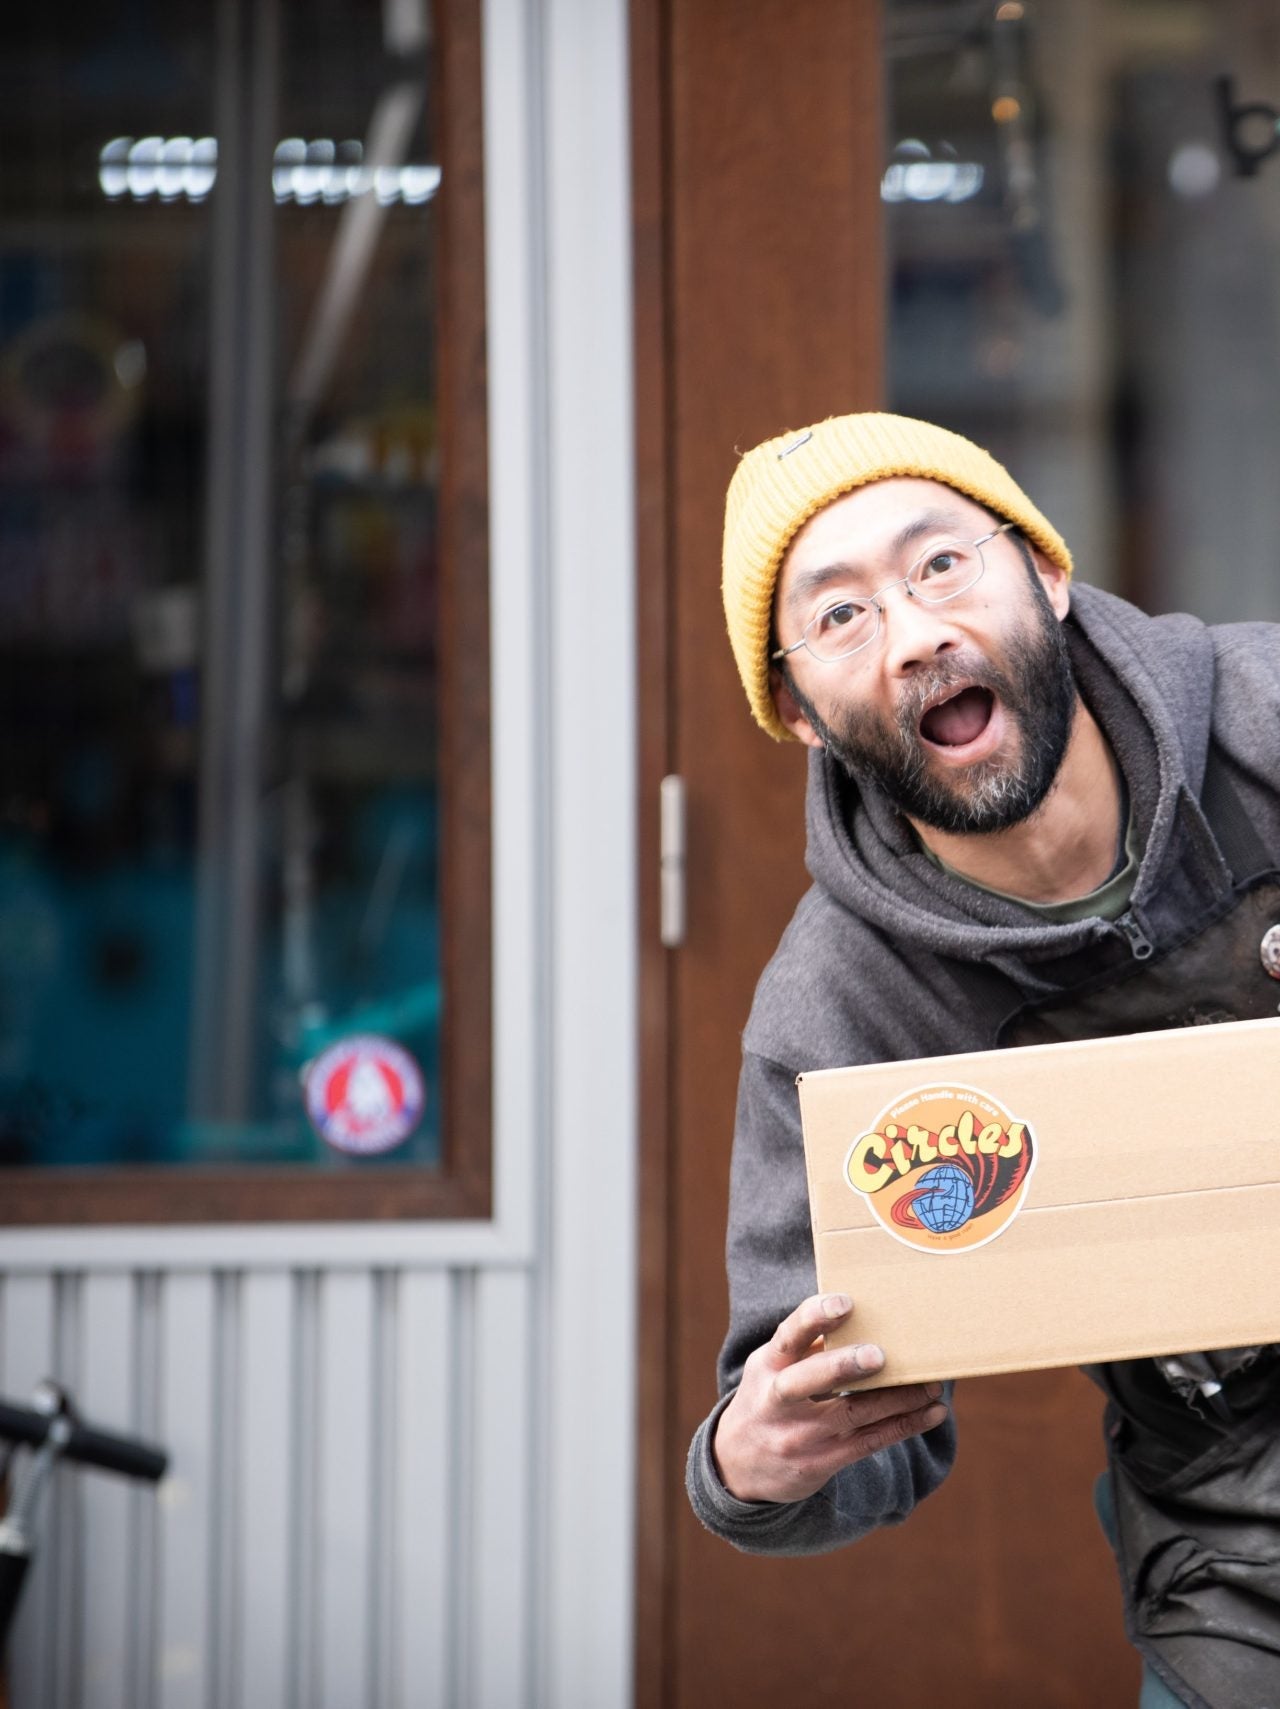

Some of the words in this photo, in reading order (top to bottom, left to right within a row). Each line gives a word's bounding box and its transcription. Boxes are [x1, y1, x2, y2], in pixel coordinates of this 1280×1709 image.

[956, 1093, 978, 1105] with
[979, 1101, 1000, 1117] care
[847, 1110, 1027, 1193] Circles
